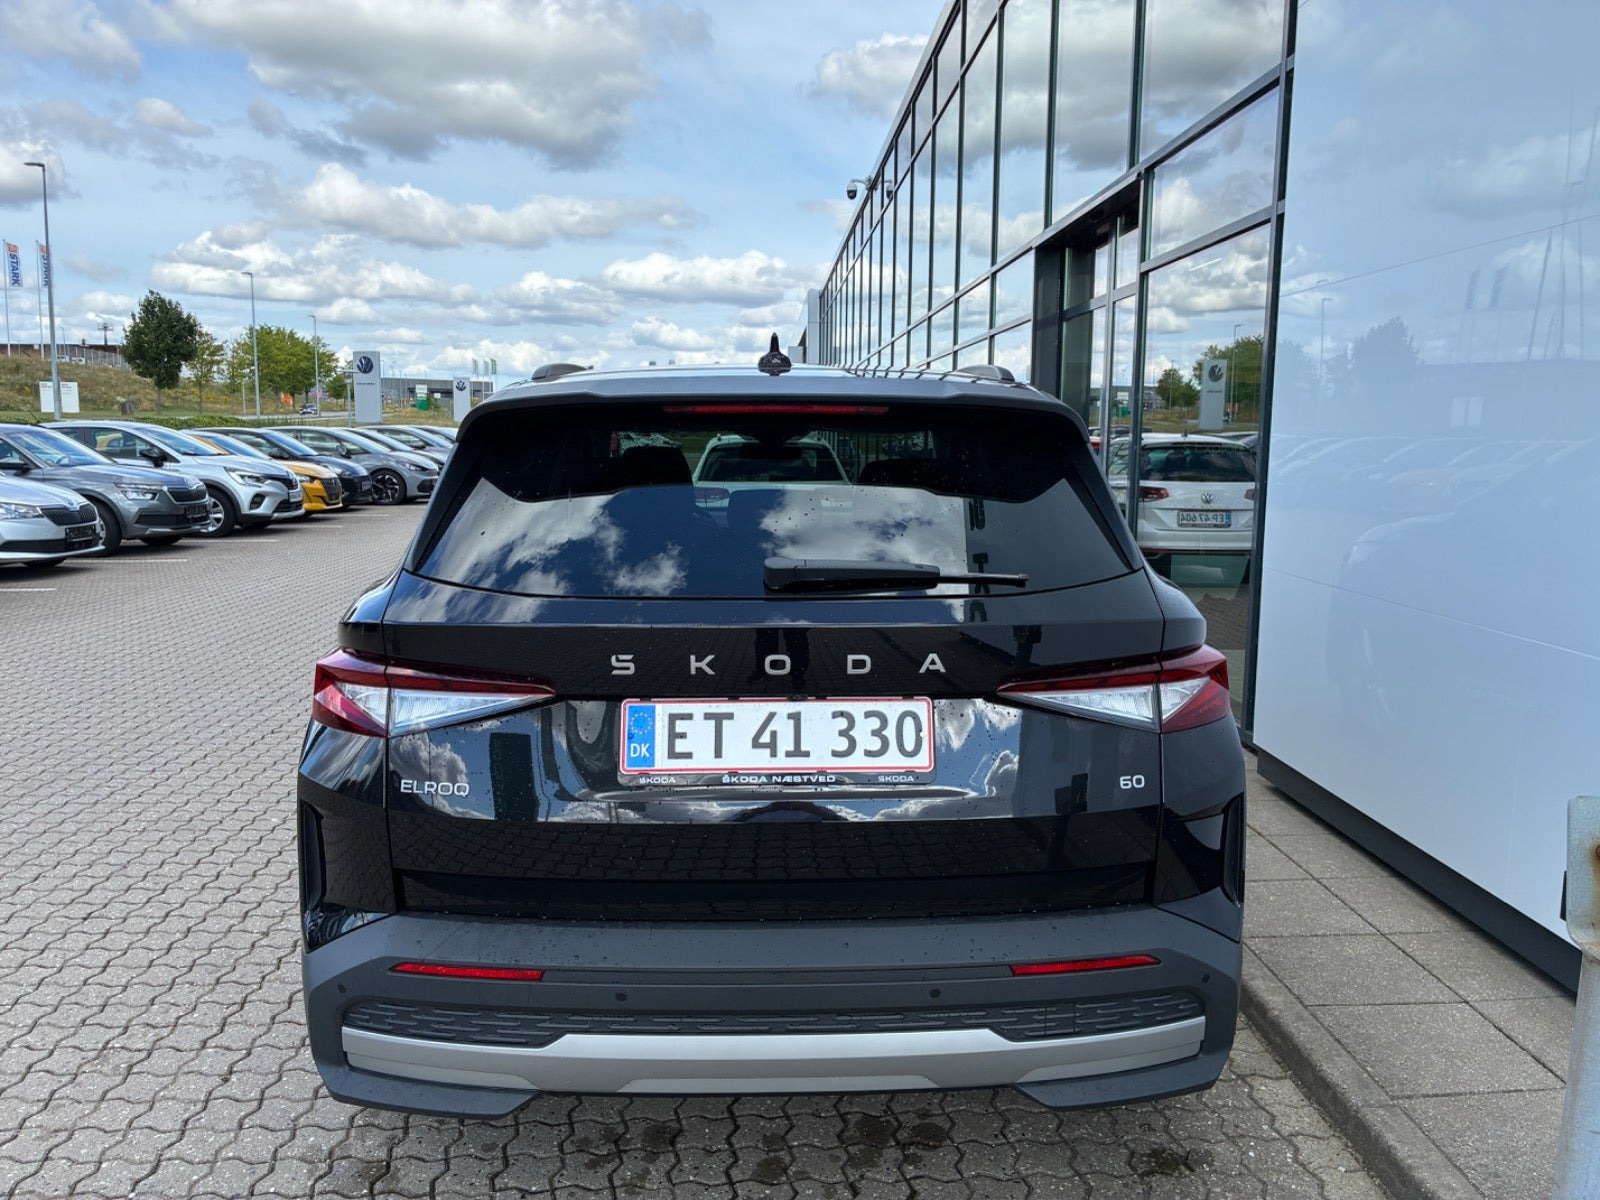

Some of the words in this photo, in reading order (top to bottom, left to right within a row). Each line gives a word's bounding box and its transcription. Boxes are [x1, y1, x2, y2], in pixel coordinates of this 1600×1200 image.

[9, 252, 20, 287] STARK
[668, 711, 735, 760] ET
[751, 711, 811, 759] 41
[831, 709, 923, 759] 330
[630, 743, 650, 758] DK
[400, 779, 470, 797] ELROQ
[1119, 774, 1145, 790] 60
